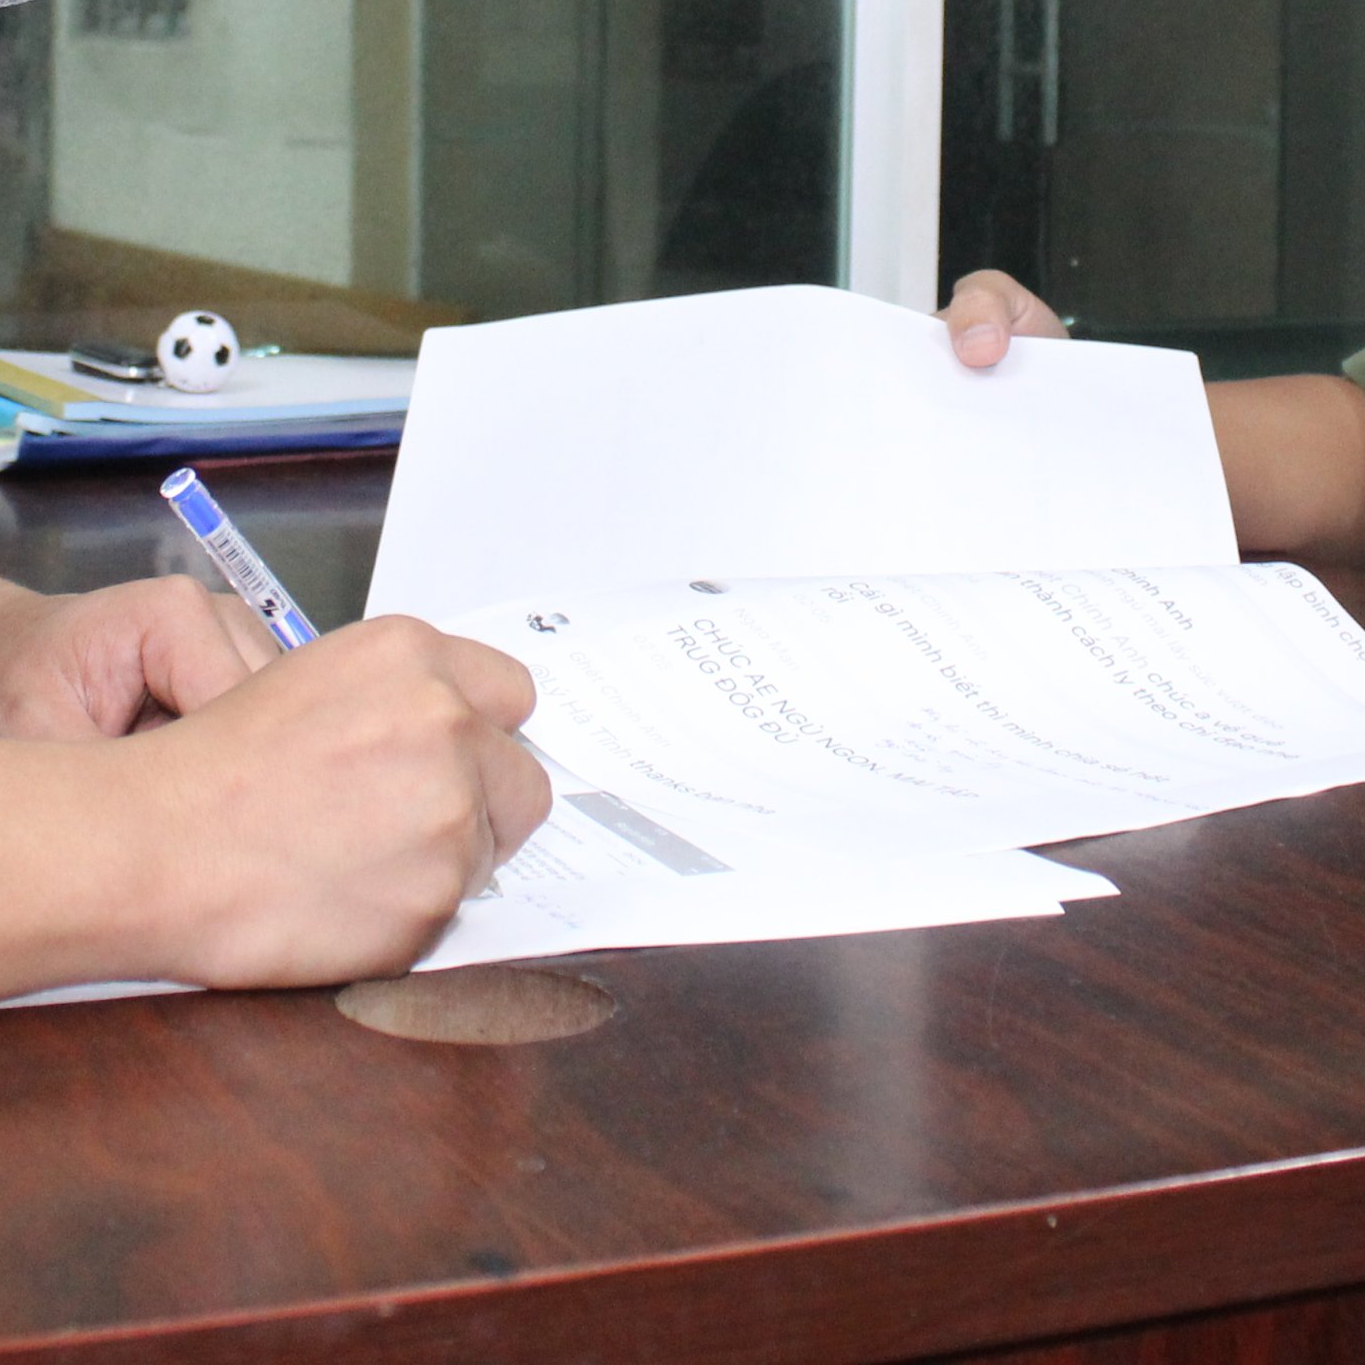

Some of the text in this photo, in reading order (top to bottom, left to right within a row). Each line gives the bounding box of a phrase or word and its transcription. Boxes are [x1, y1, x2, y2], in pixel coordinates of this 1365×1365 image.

[820, 586, 855, 603] rồi
[1158, 600, 1193, 630] Anh
[1302, 591, 1340, 628] bình
[849, 581, 886, 601] Cái
[896, 619, 942, 664] mình
[939, 664, 982, 699] biết
[976, 700, 1009, 721] thì
[1002, 721, 1054, 750] mình
[1020, 579, 1073, 623] thành
[1071, 625, 1117, 669] cách
[1132, 687, 1178, 720] theo
[1110, 636, 1149, 669] Anh
[1147, 671, 1195, 710] chúc
[666, 624, 722, 675] TRUG
[758, 719, 800, 746] ĐỦ
[693, 618, 752, 670] CHÚC
[743, 673, 780, 699] AE
[770, 698, 825, 737] NGỦ
[639, 723, 673, 750] Anh
[629, 759, 697, 795] thanks
